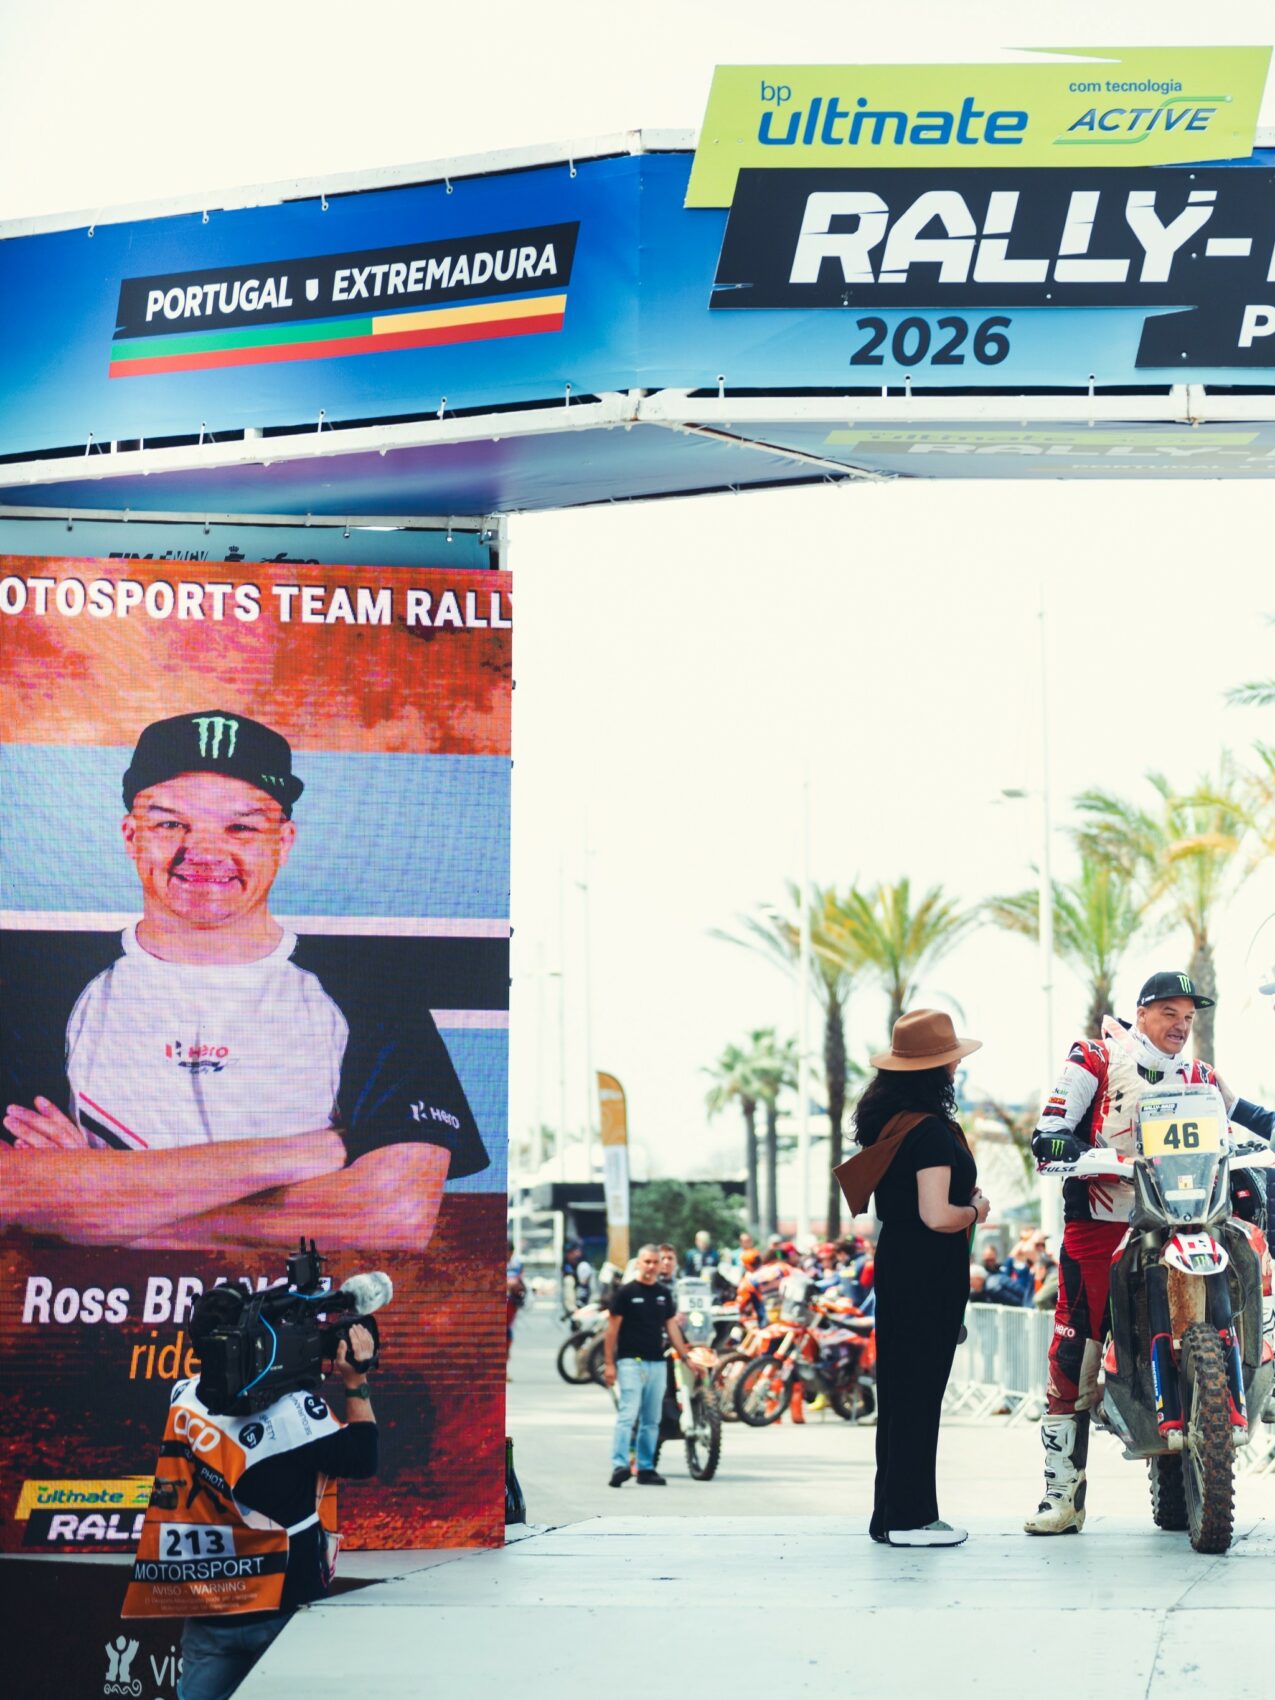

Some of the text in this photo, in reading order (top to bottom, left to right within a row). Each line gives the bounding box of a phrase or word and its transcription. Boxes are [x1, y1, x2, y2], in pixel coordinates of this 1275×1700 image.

[760, 80, 792, 106] bp
[1069, 79, 1182, 95] com tecnologia
[757, 97, 1029, 145] ultimate
[1067, 108, 1217, 131] ACTIVE
[145, 243, 558, 322] PORTUGAL EXTREMADURA
[849, 316, 1013, 366] 2026
[272, 585, 392, 625] TEAM
[1163, 1122, 1200, 1149] 46
[22, 1276, 130, 1324] Ross
[37, 1488, 124, 1504] ultimate
[166, 1529, 226, 1557] 213
[134, 1556, 265, 1581] MOTORSPORT
[189, 1580, 247, 1595] WARNING
